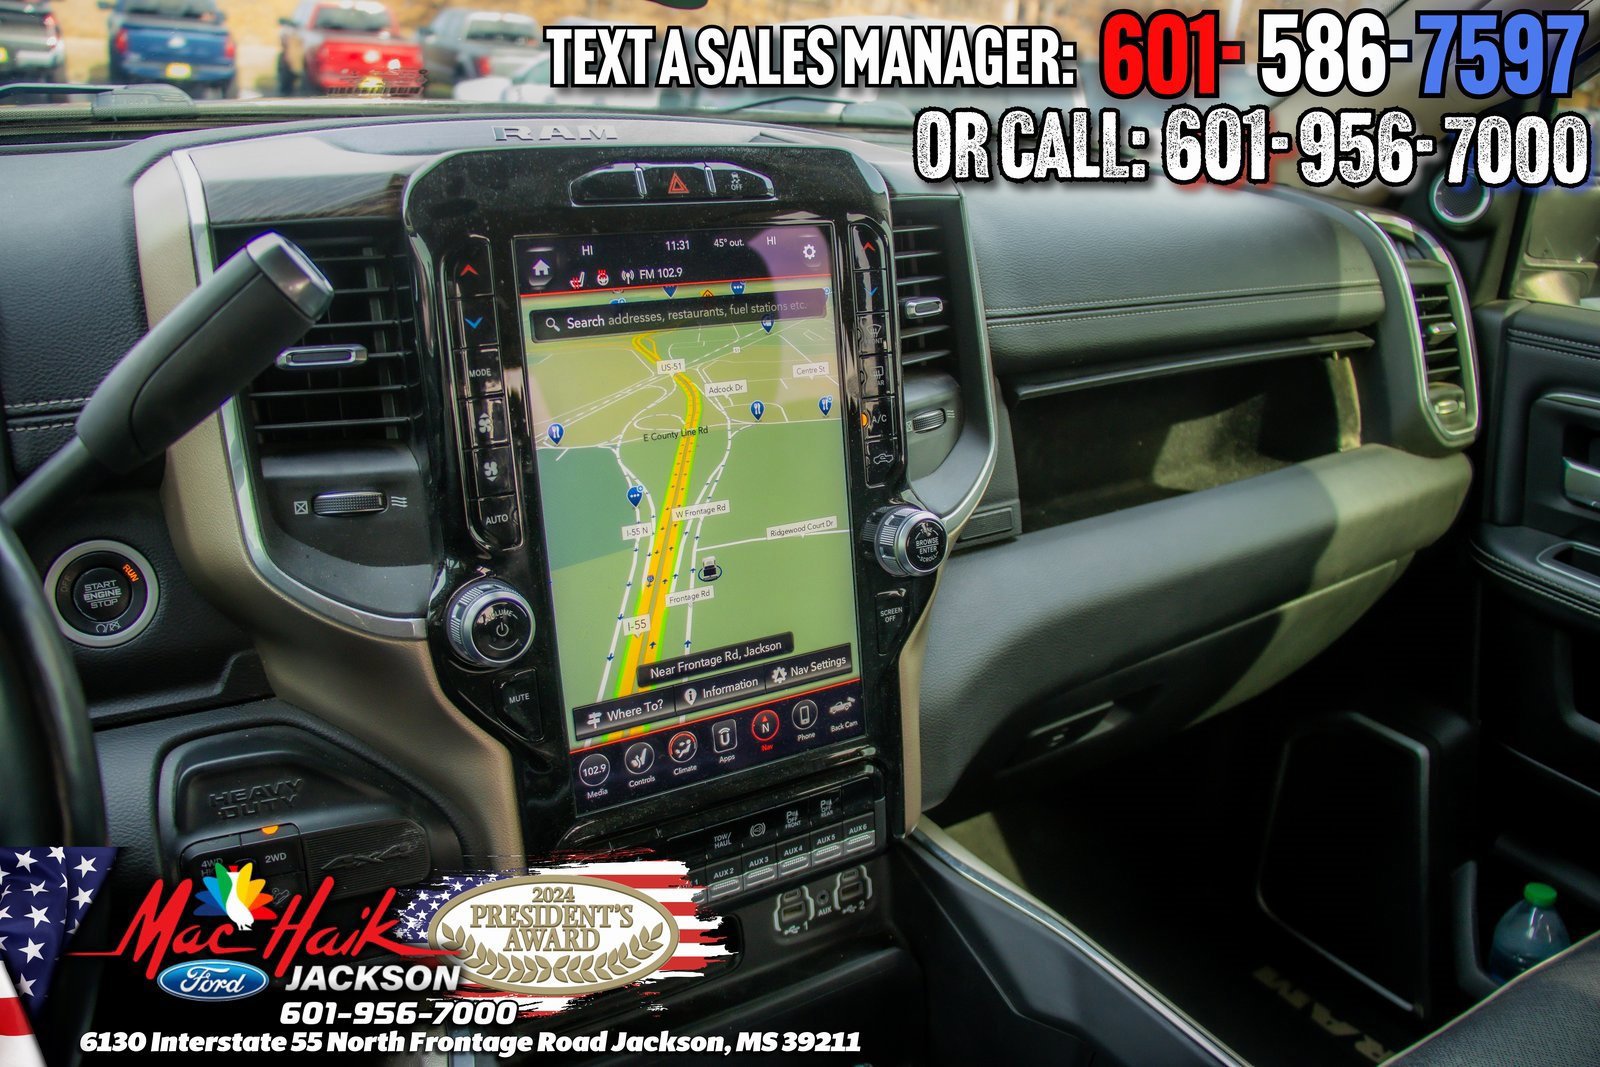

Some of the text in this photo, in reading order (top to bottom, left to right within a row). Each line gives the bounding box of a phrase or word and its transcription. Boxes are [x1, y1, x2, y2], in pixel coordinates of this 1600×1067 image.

[492, 125, 618, 141] RAM
[730, 183, 743, 191] OFF
[582, 245, 593, 256] HI
[665, 239, 690, 251] 11:31
[766, 235, 777, 245] HI
[639, 267, 683, 280] FM 102.9
[567, 301, 807, 329] Search addresses, restaurants, fuel stations etc.
[661, 361, 682, 372] US-51
[796, 367, 818, 376] Centre
[469, 368, 491, 378] MODE
[708, 384, 744, 395] Adcock Dr
[872, 414, 887, 424] A/C
[643, 426, 708, 441] E County Line Rd
[676, 504, 726, 518] W Frontage Rd
[485, 513, 509, 525] AUTO
[626, 528, 641, 536] I-55
[770, 519, 834, 537] Ridgewood Court Dr
[915, 536, 939, 547] BROWSE
[919, 545, 938, 555] ENTER
[122, 563, 139, 582] RUN
[84, 580, 117, 592] START
[83, 588, 122, 601] ENGINE
[669, 590, 711, 604] Frontage Rd
[90, 598, 118, 609] STOP
[880, 606, 903, 617] SCREEN
[627, 619, 647, 631] I-55
[884, 615, 896, 623] OFF
[650, 640, 782, 679] Near Frontage Rd, Jackson
[790, 656, 847, 677] Nav Settings
[703, 677, 759, 700] Information
[509, 692, 530, 704] MUTE
[607, 699, 664, 722] Where To?
[830, 719, 858, 733] Back Cam
[797, 730, 816, 742] Phone
[761, 743, 774, 751] Nav
[718, 754, 736, 765] Apps
[582, 764, 607, 777] 102.9
[673, 764, 698, 776] Climate
[628, 775, 656, 788] Controls
[208, 778, 303, 807] HEAVY
[586, 787, 609, 799] Media
[218, 794, 297, 817] DUTY
[849, 823, 867, 835] AUX 6
[713, 832, 732, 843] TOW/
[714, 838, 732, 849] HAUL
[816, 833, 836, 845] AUX 5
[784, 845, 803, 856] AUX 4
[265, 852, 287, 864] 2WD
[749, 857, 763, 868] AUX
[713, 867, 734, 880] AUX 2
[859, 900, 865, 910] 2
[818, 906, 832, 917] AUX
[804, 921, 809, 931] 1
